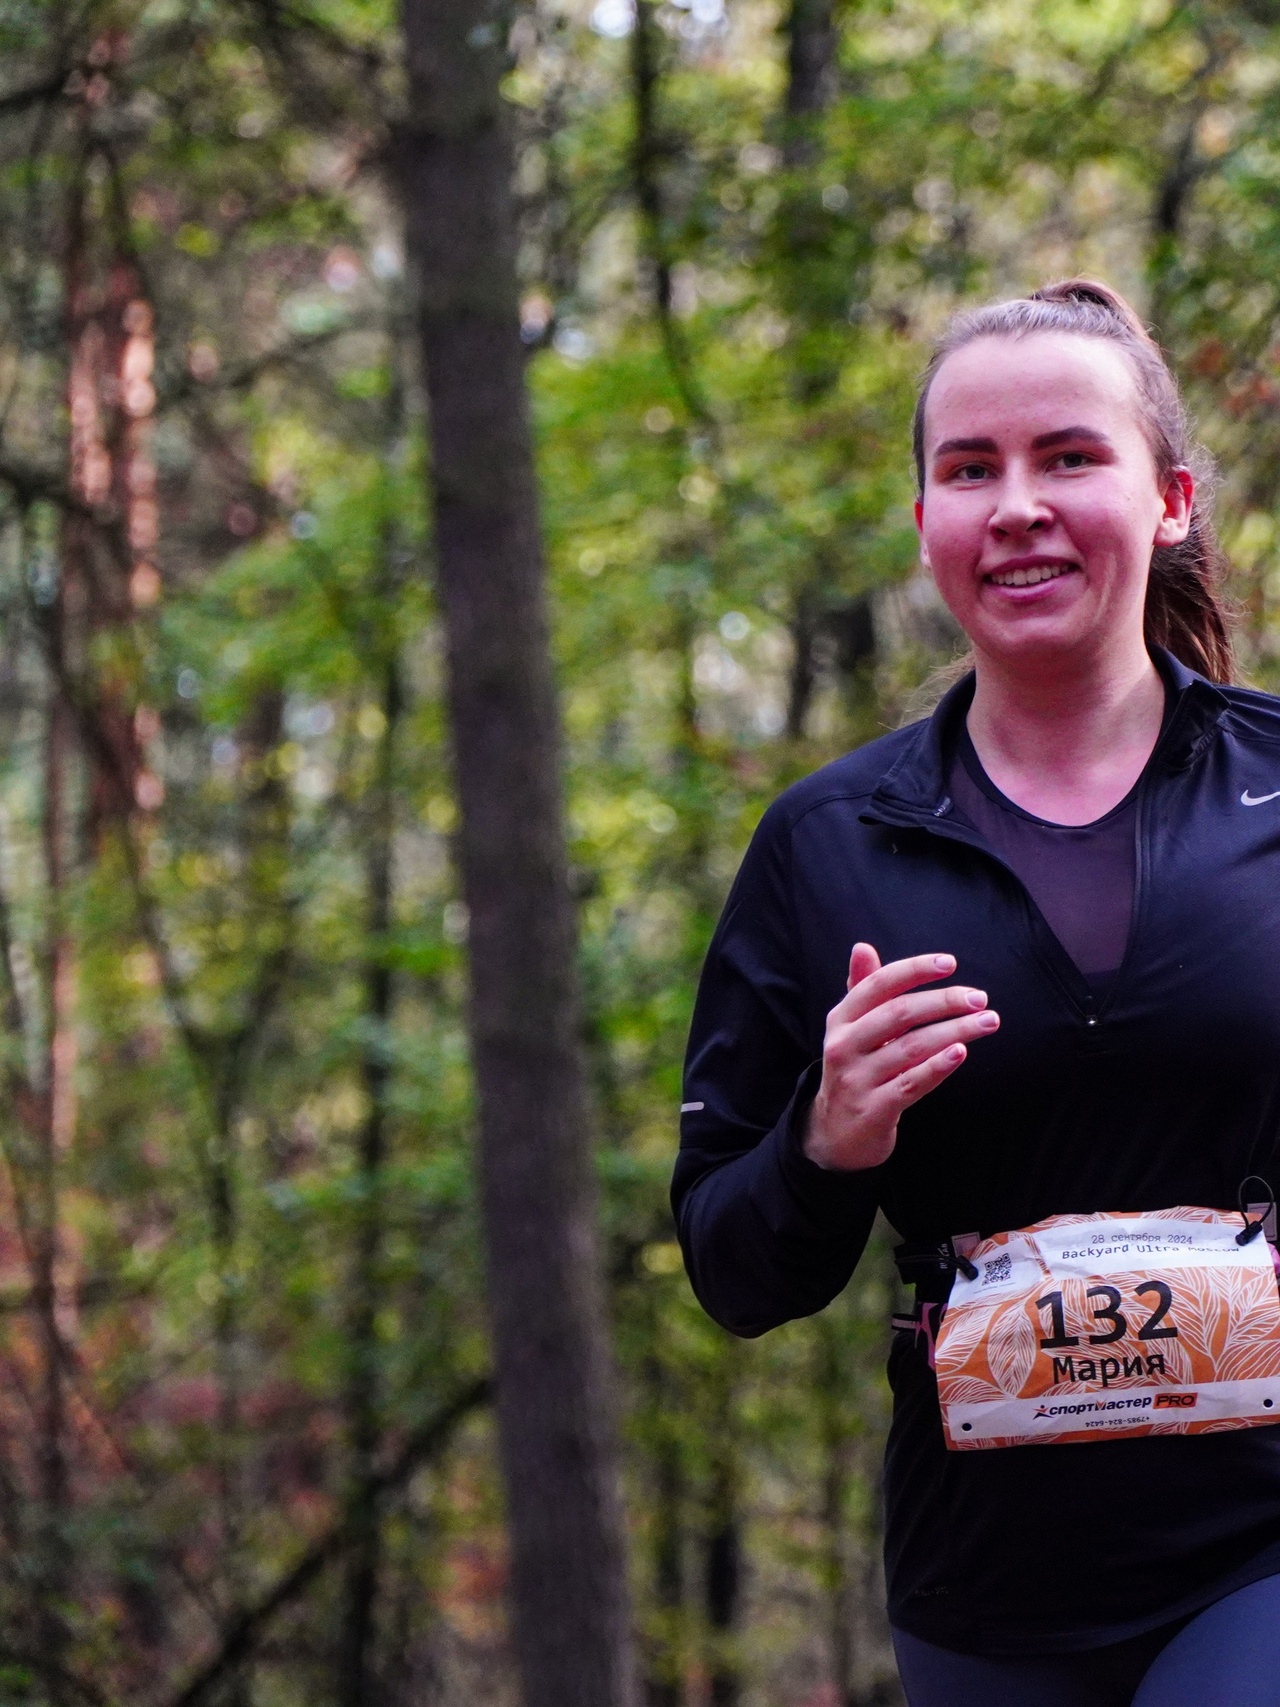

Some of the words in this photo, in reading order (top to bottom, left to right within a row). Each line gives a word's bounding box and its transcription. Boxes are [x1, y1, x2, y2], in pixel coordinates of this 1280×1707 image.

[1091, 1234, 1105, 1245] 28
[1111, 1232, 1161, 1243] сентября
[1167, 1234, 1193, 1245] 2024
[1062, 1244, 1129, 1260] Backyard
[1136, 1244, 1180, 1253] Ultra
[1035, 1280, 1178, 1349] 132
[1052, 1353, 1166, 1388] Мария
[1155, 1394, 1196, 1407] PRO
